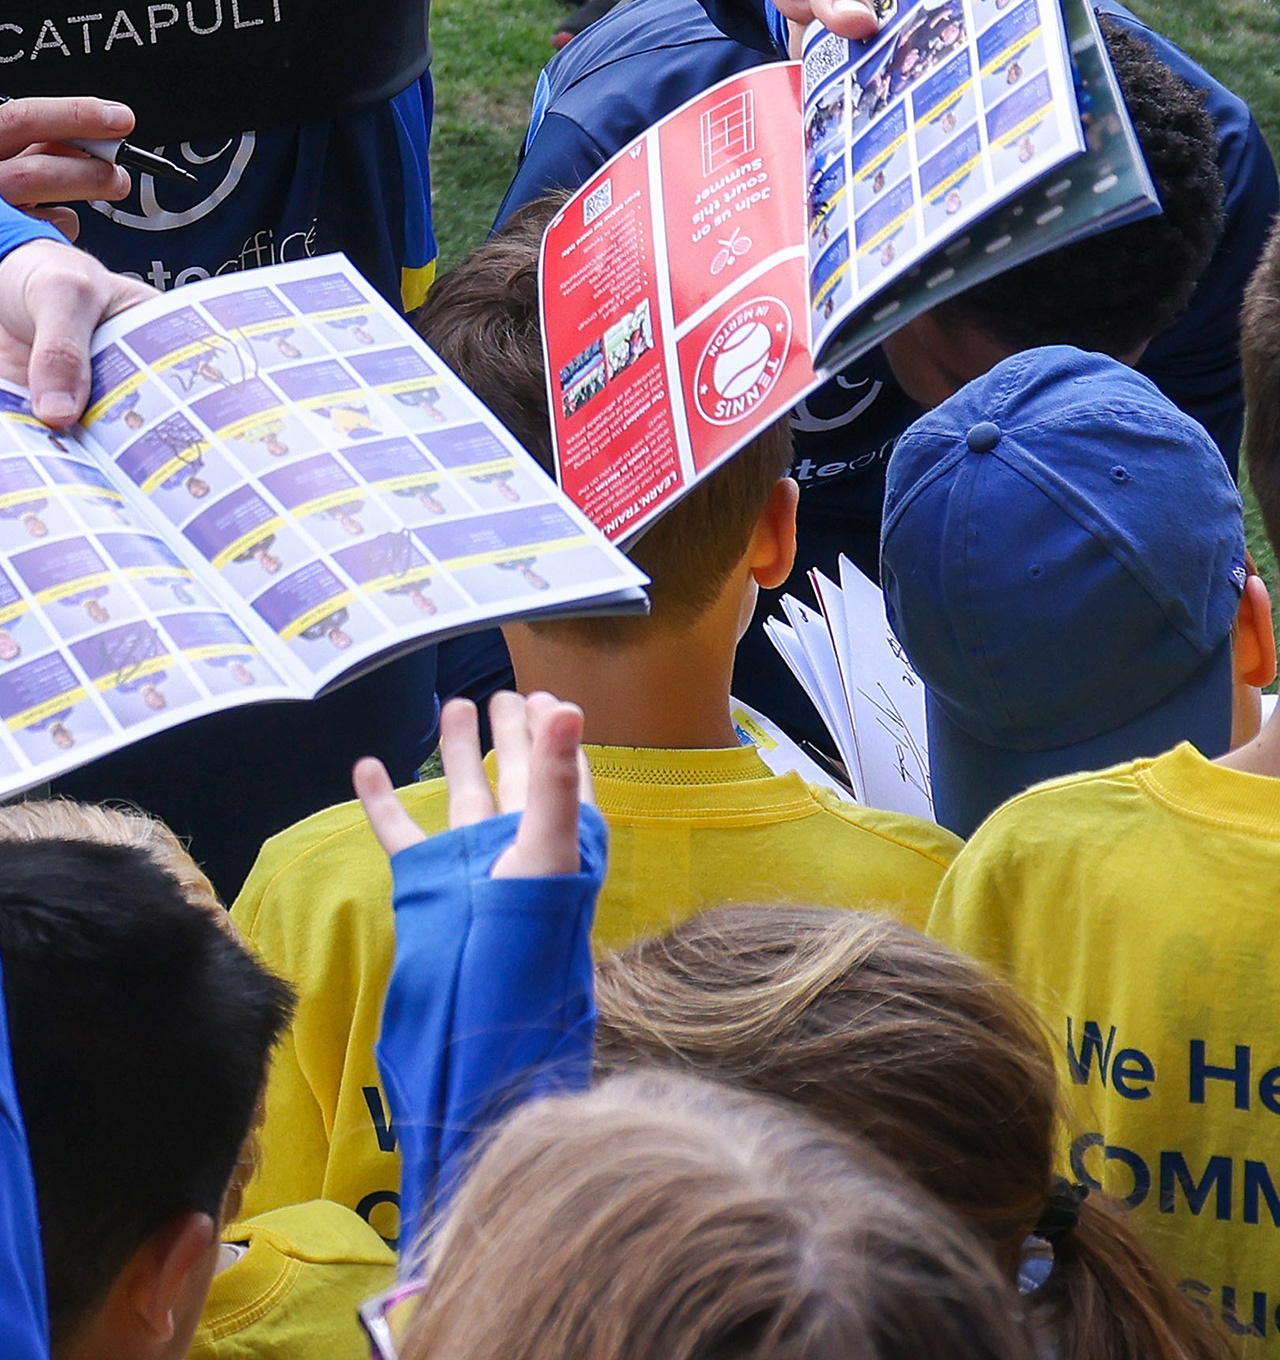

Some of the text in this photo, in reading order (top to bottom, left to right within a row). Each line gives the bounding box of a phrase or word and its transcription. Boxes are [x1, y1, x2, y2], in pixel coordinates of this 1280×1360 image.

[691, 170, 767, 226] court this
[693, 156, 762, 205] Summer
[691, 185, 770, 243] Join us on
[706, 305, 769, 356] IN MERTON
[713, 359, 780, 417] TENNIS
[1067, 1016, 1155, 1101] We
